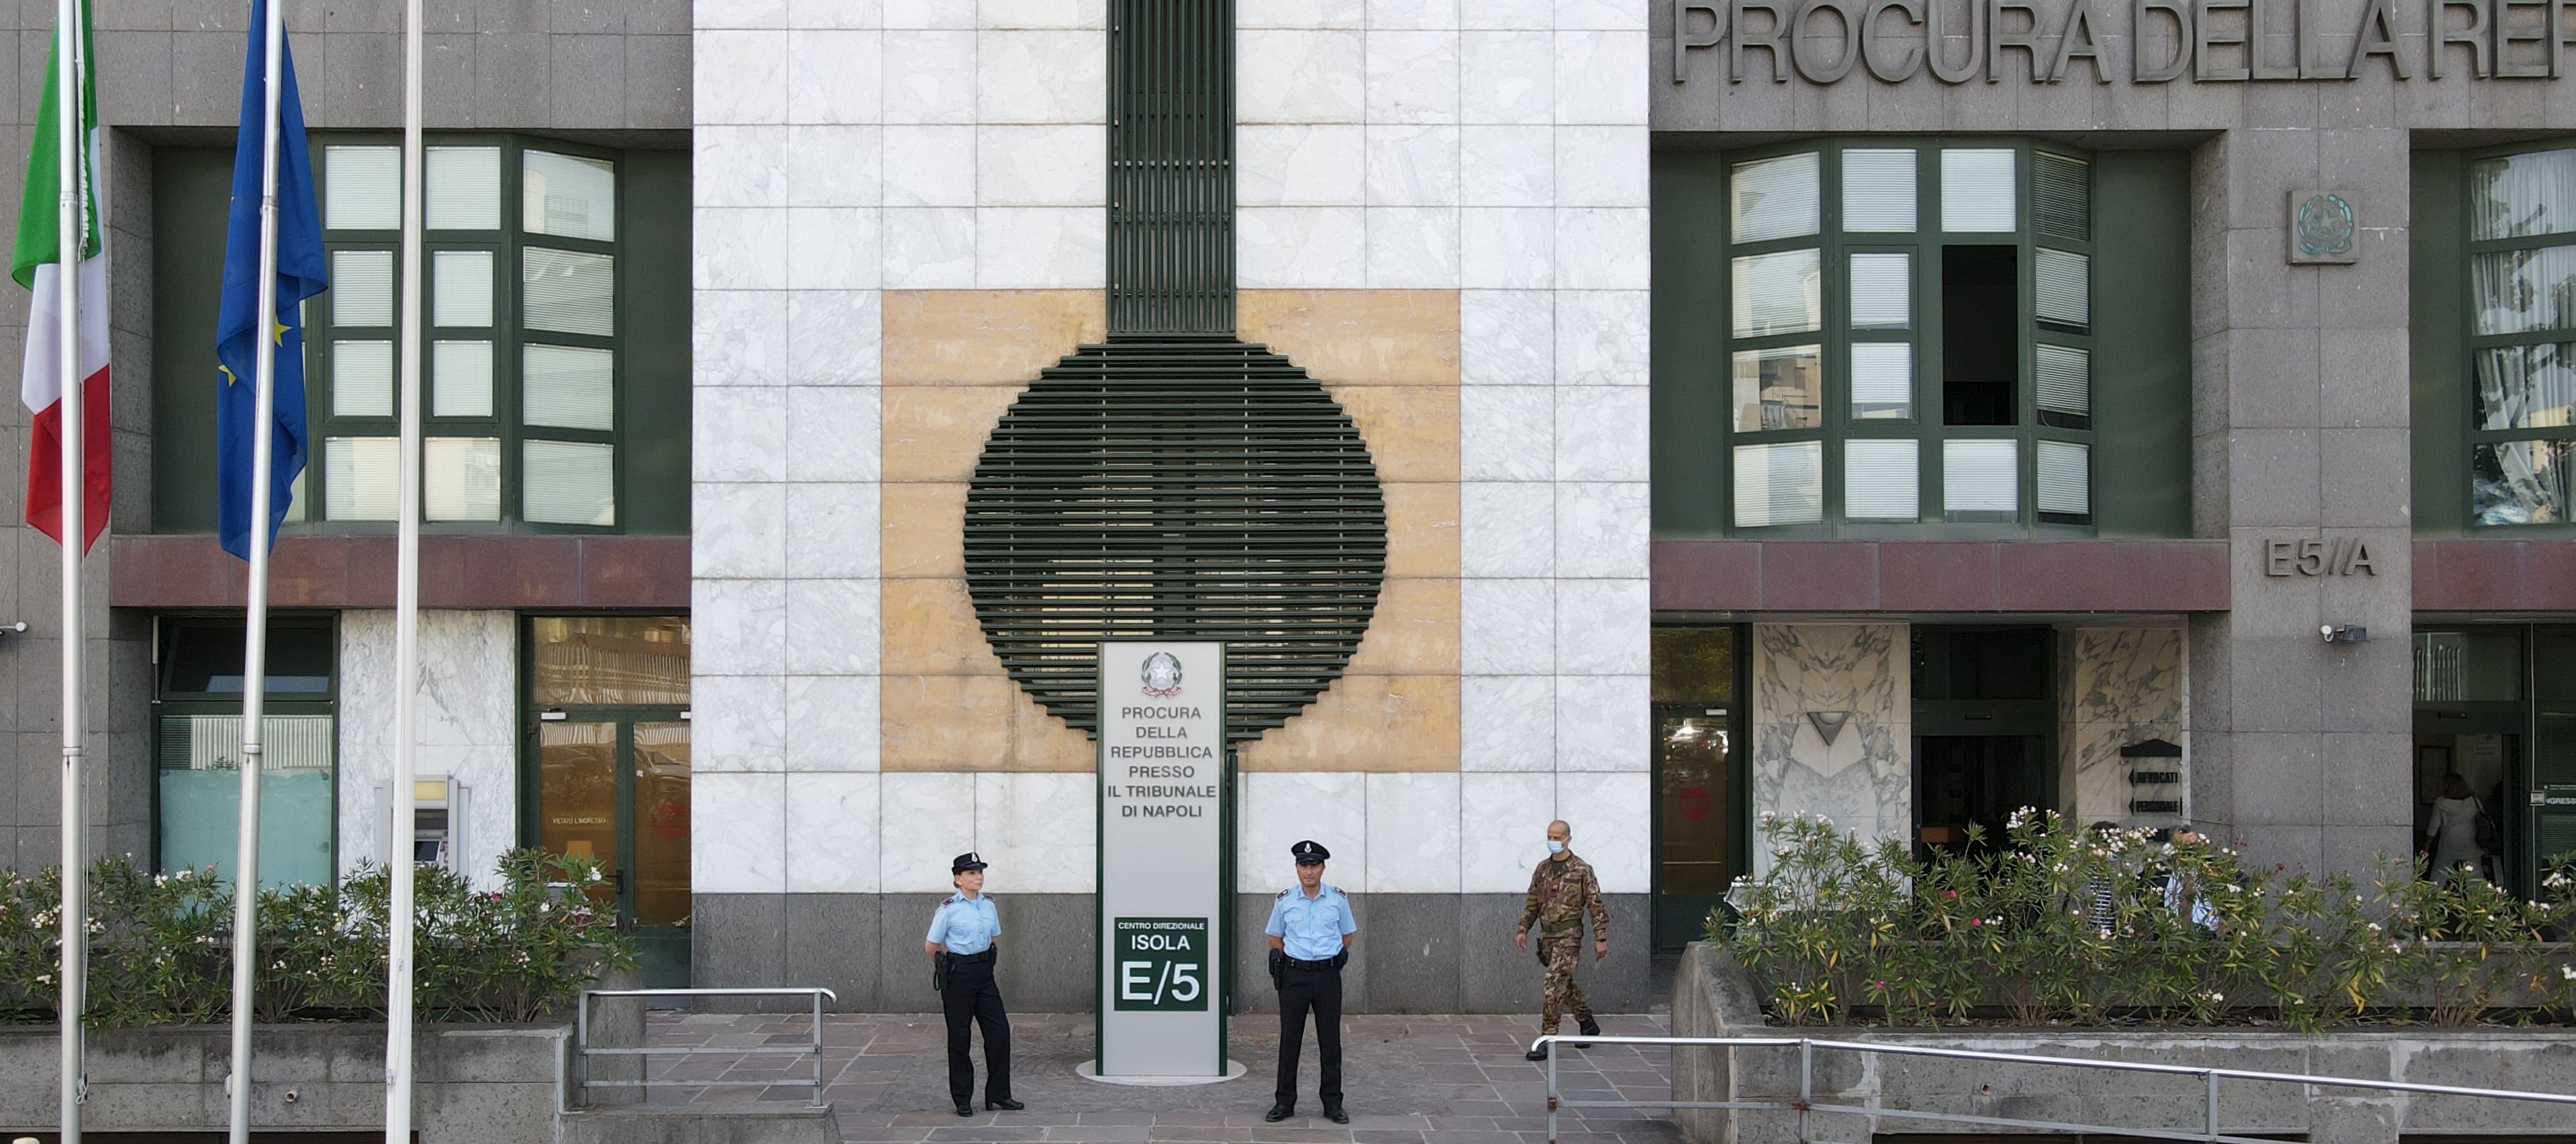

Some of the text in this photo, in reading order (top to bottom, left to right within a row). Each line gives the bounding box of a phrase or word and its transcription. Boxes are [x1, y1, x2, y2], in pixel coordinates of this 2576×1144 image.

[1673, 0, 2113, 84] PROCURA
[2132, 0, 2412, 83] DELLA
[2265, 537, 2377, 576] E5/A
[1122, 707, 1201, 719] PROCURA
[1136, 727, 1187, 739] DELLA
[1110, 746, 1213, 758] REPUBBLICA
[1129, 766, 1195, 778] PRESSO
[2136, 772, 2179, 784] AVVOCATI
[1107, 785, 1216, 798] IL TRIBUNALE
[1122, 805, 1202, 818] DI NAPOLI
[1118, 922, 1205, 931] CENTRO DIREZIONALE
[1131, 934, 1191, 951] ISOLA
[1122, 960, 1201, 1005] E/5
